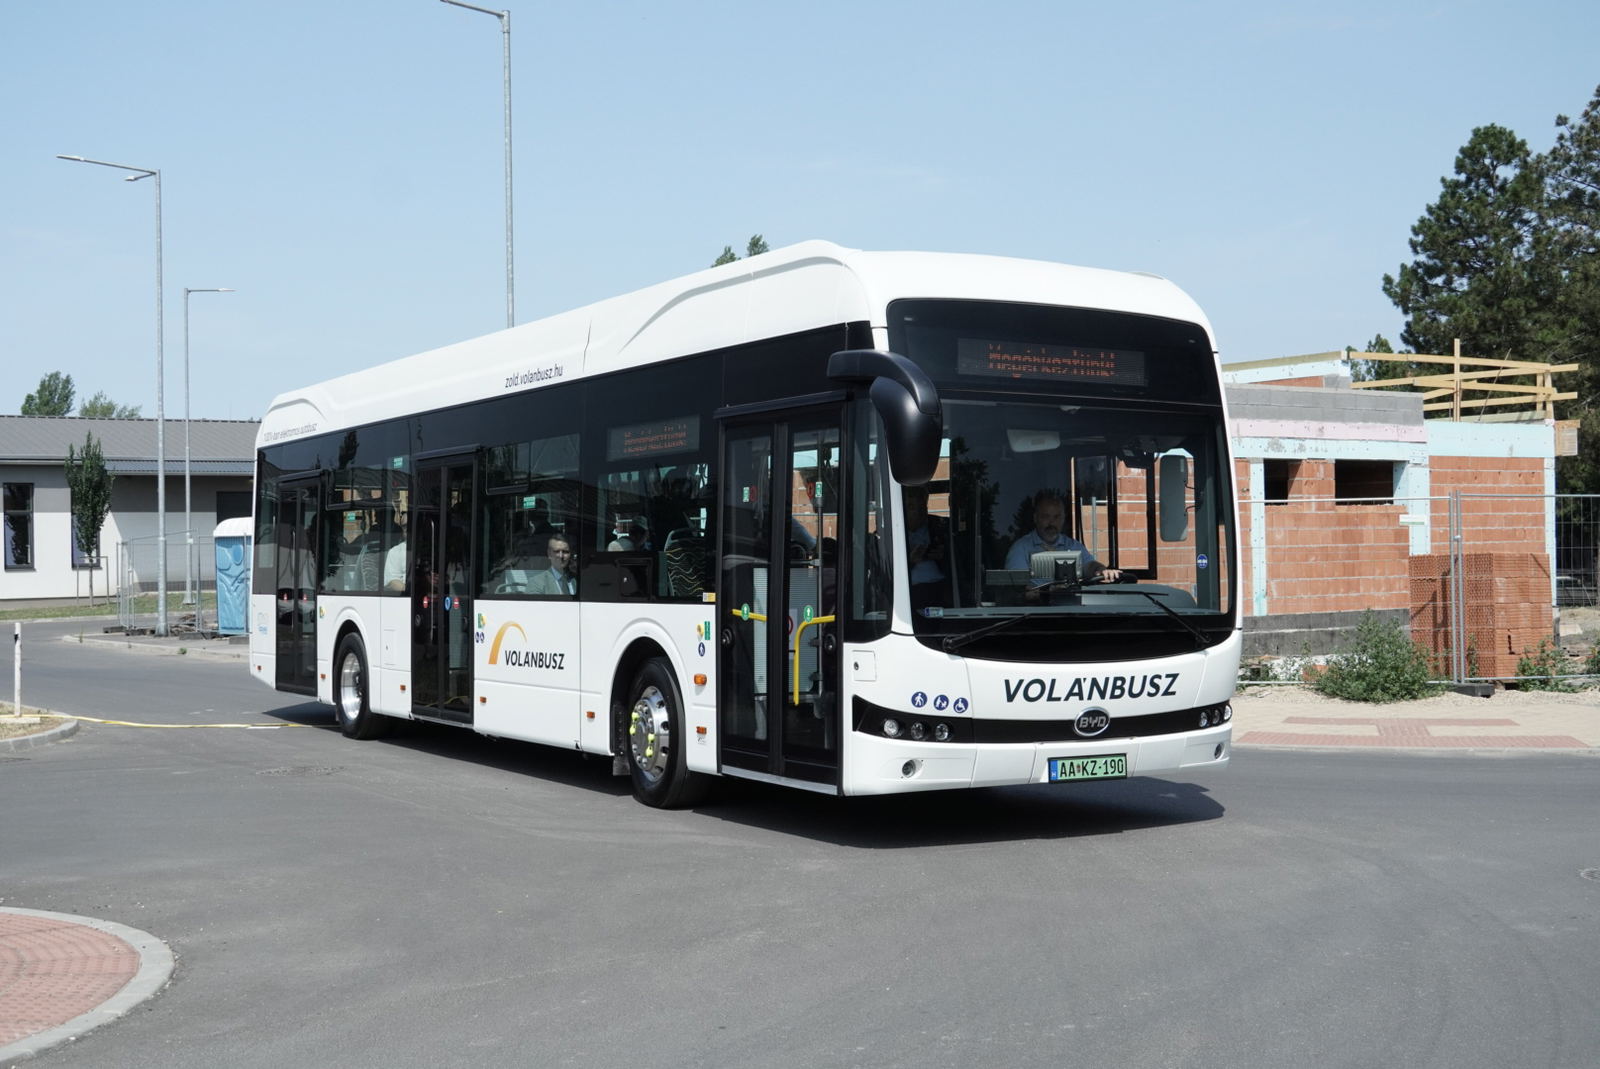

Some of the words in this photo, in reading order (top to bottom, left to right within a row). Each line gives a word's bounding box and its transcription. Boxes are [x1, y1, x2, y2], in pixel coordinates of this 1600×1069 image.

[504, 363, 563, 388] zold.volanbusz.hu
[505, 650, 565, 670] VOLÁNBUSZ
[1004, 673, 1180, 703] VOLÁNBUSZ
[1079, 716, 1107, 728] BYD
